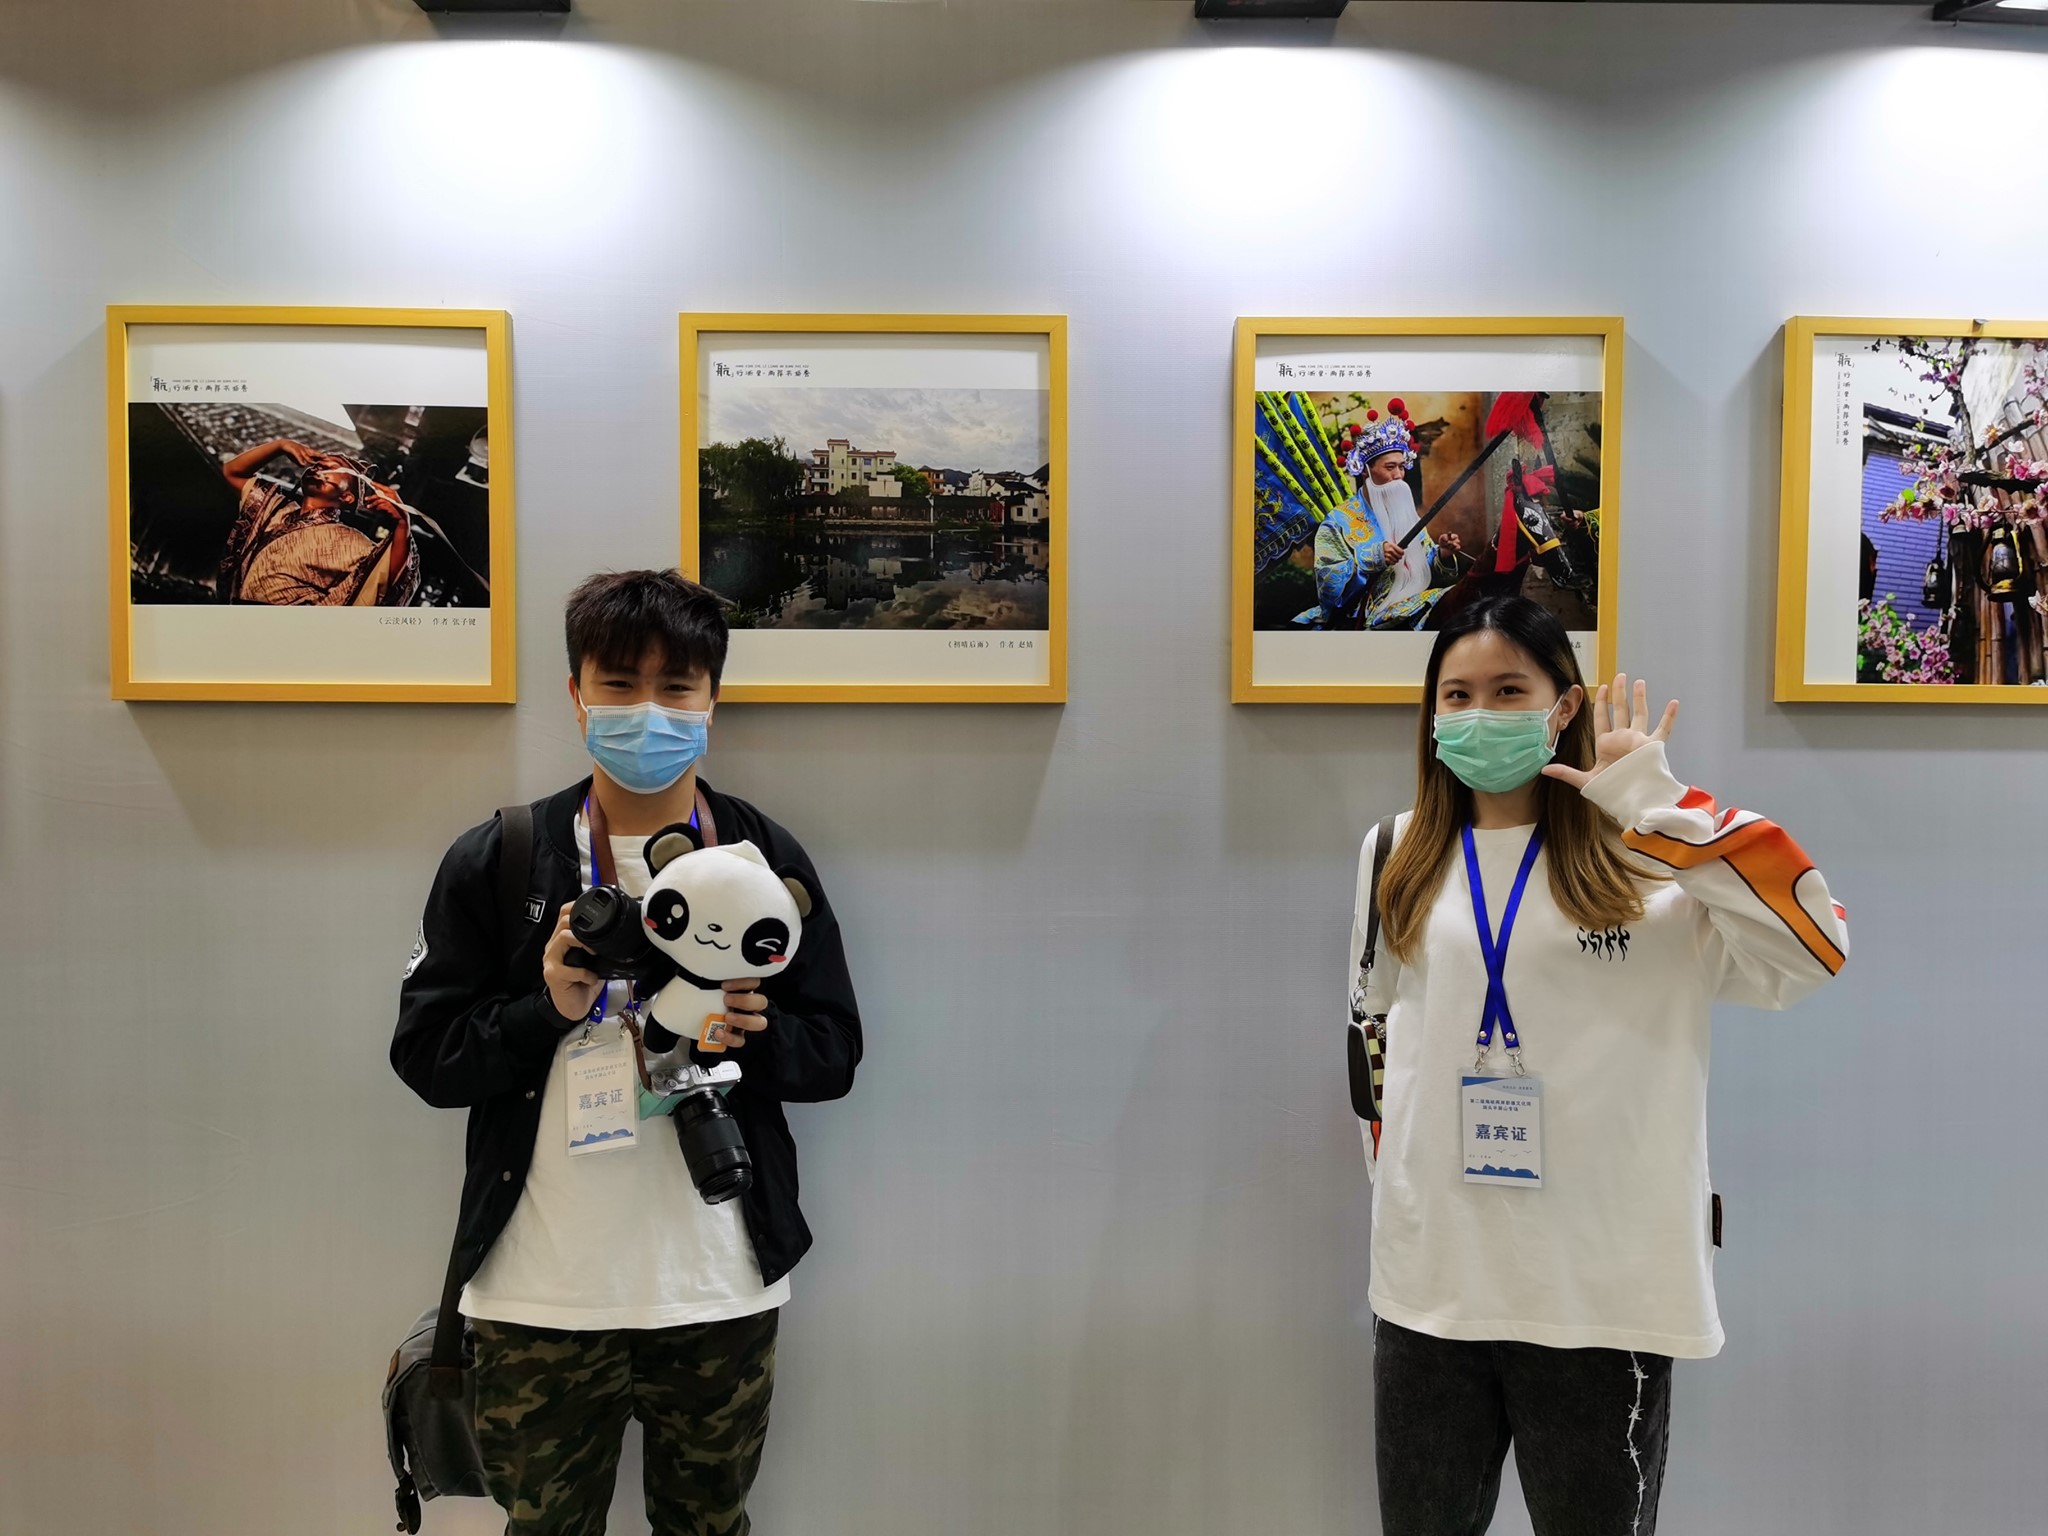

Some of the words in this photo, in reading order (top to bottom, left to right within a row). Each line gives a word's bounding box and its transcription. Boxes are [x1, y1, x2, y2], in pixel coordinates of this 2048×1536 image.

[432, 617, 449, 626] 作者
[999, 640, 1015, 649] 作者
[579, 1088, 624, 1110] 嘉宾证
[1475, 1124, 1528, 1142] 嘉宾证
